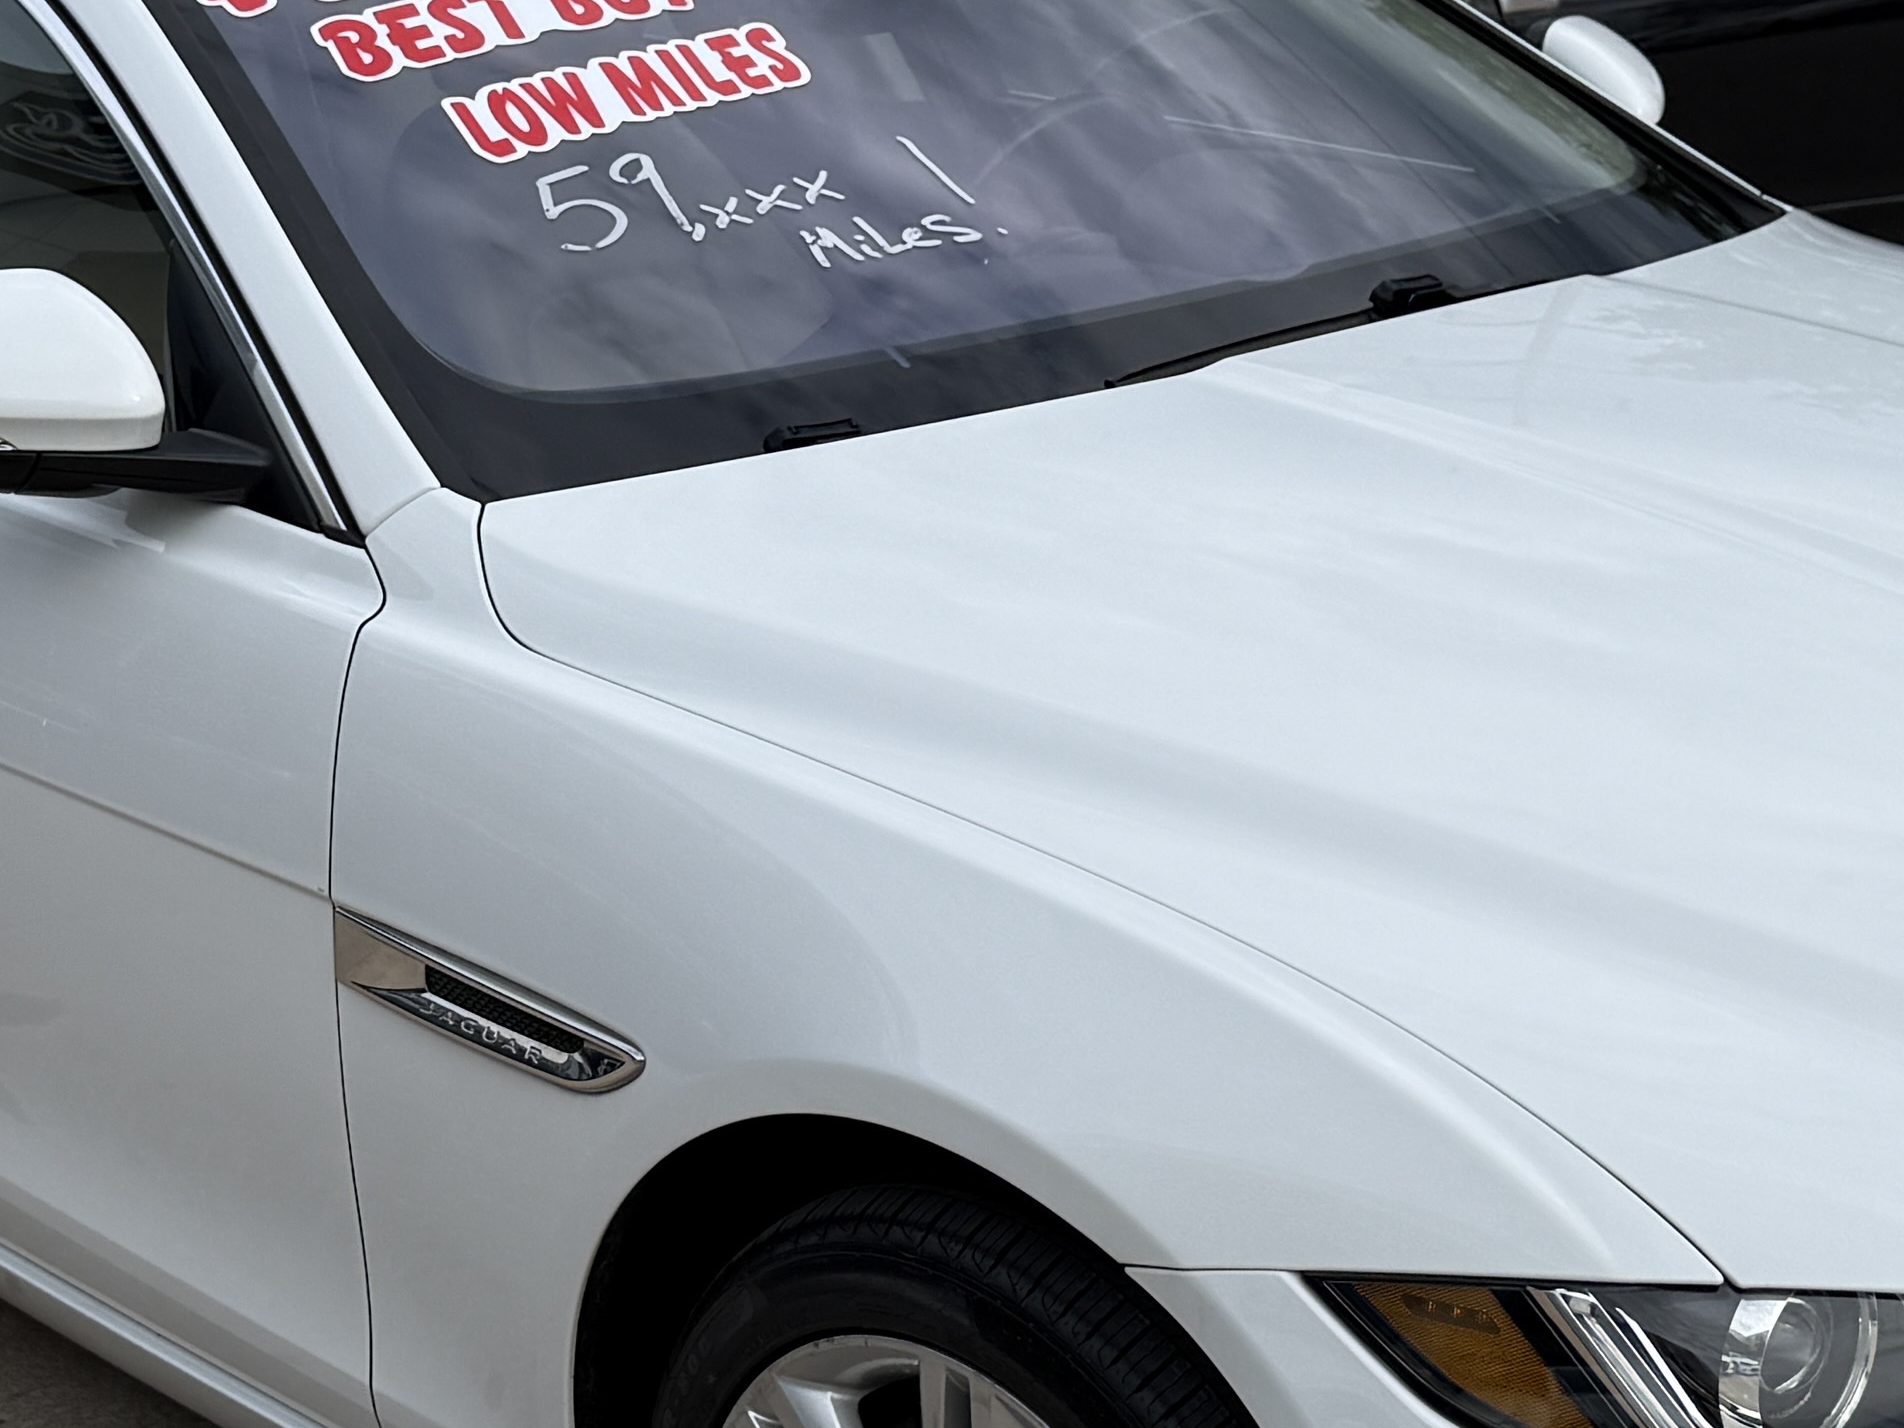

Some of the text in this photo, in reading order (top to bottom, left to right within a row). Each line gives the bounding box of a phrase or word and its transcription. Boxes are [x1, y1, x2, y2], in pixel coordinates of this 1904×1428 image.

[445, 23, 810, 162] LOW MILES
[418, 1001, 544, 1065] JAGUAR
